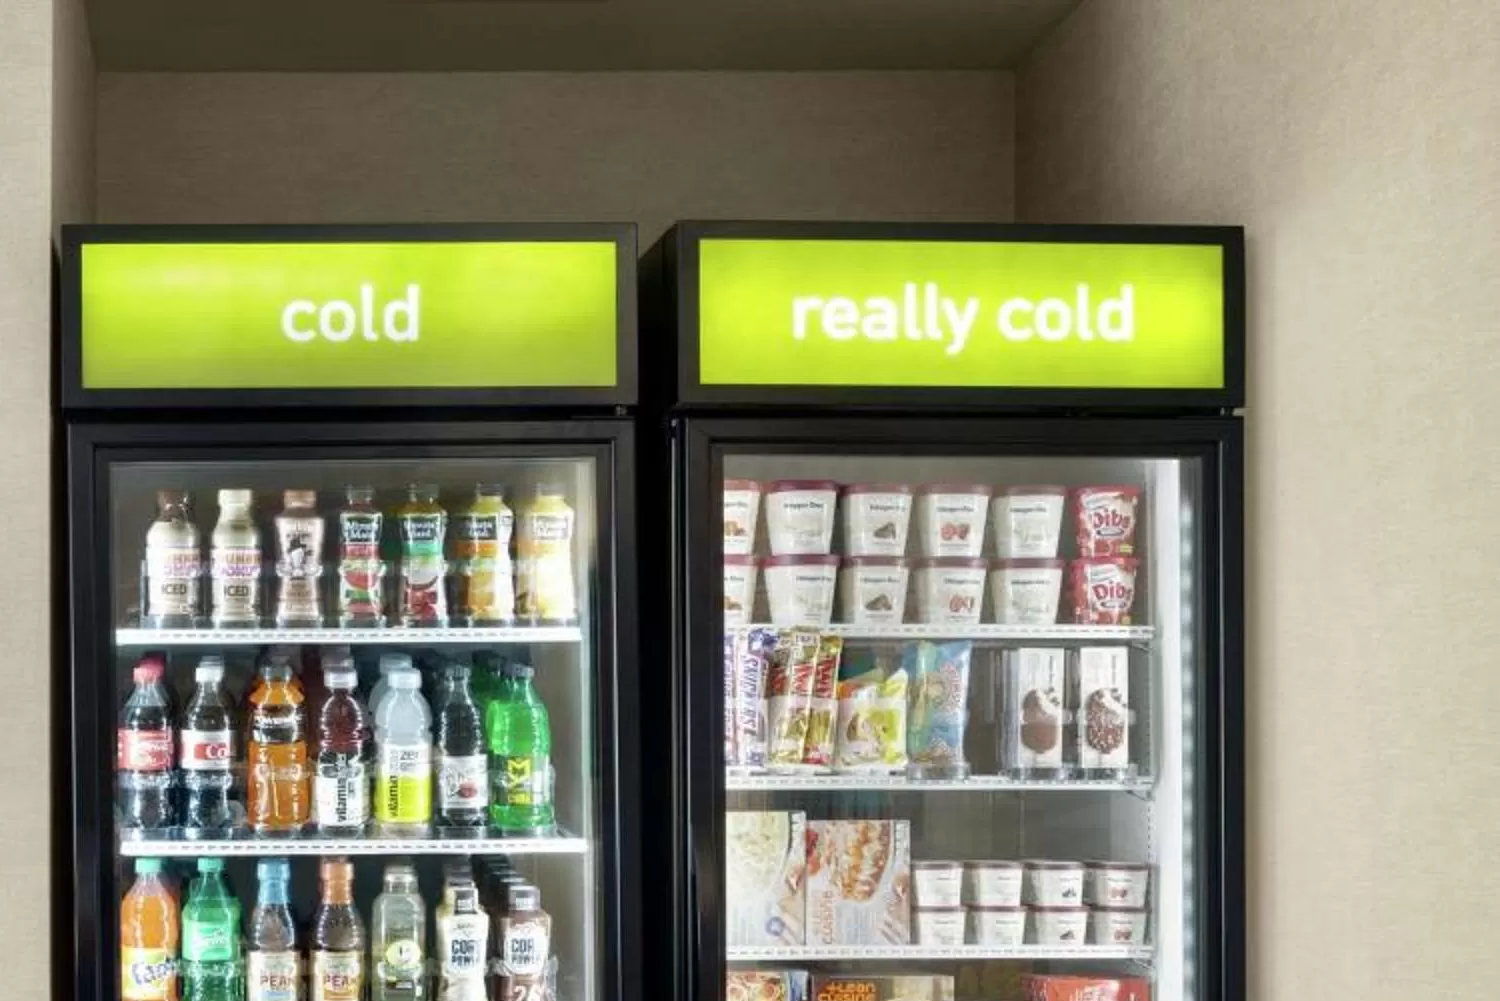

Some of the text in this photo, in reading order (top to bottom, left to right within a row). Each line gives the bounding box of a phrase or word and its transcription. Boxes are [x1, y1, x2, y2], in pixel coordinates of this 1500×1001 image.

[280, 284, 421, 342] cold
[791, 284, 1136, 354] really cold
[162, 583, 187, 595] ICED
[223, 585, 249, 596] ICED
[1092, 581, 1133, 601] Dibs
